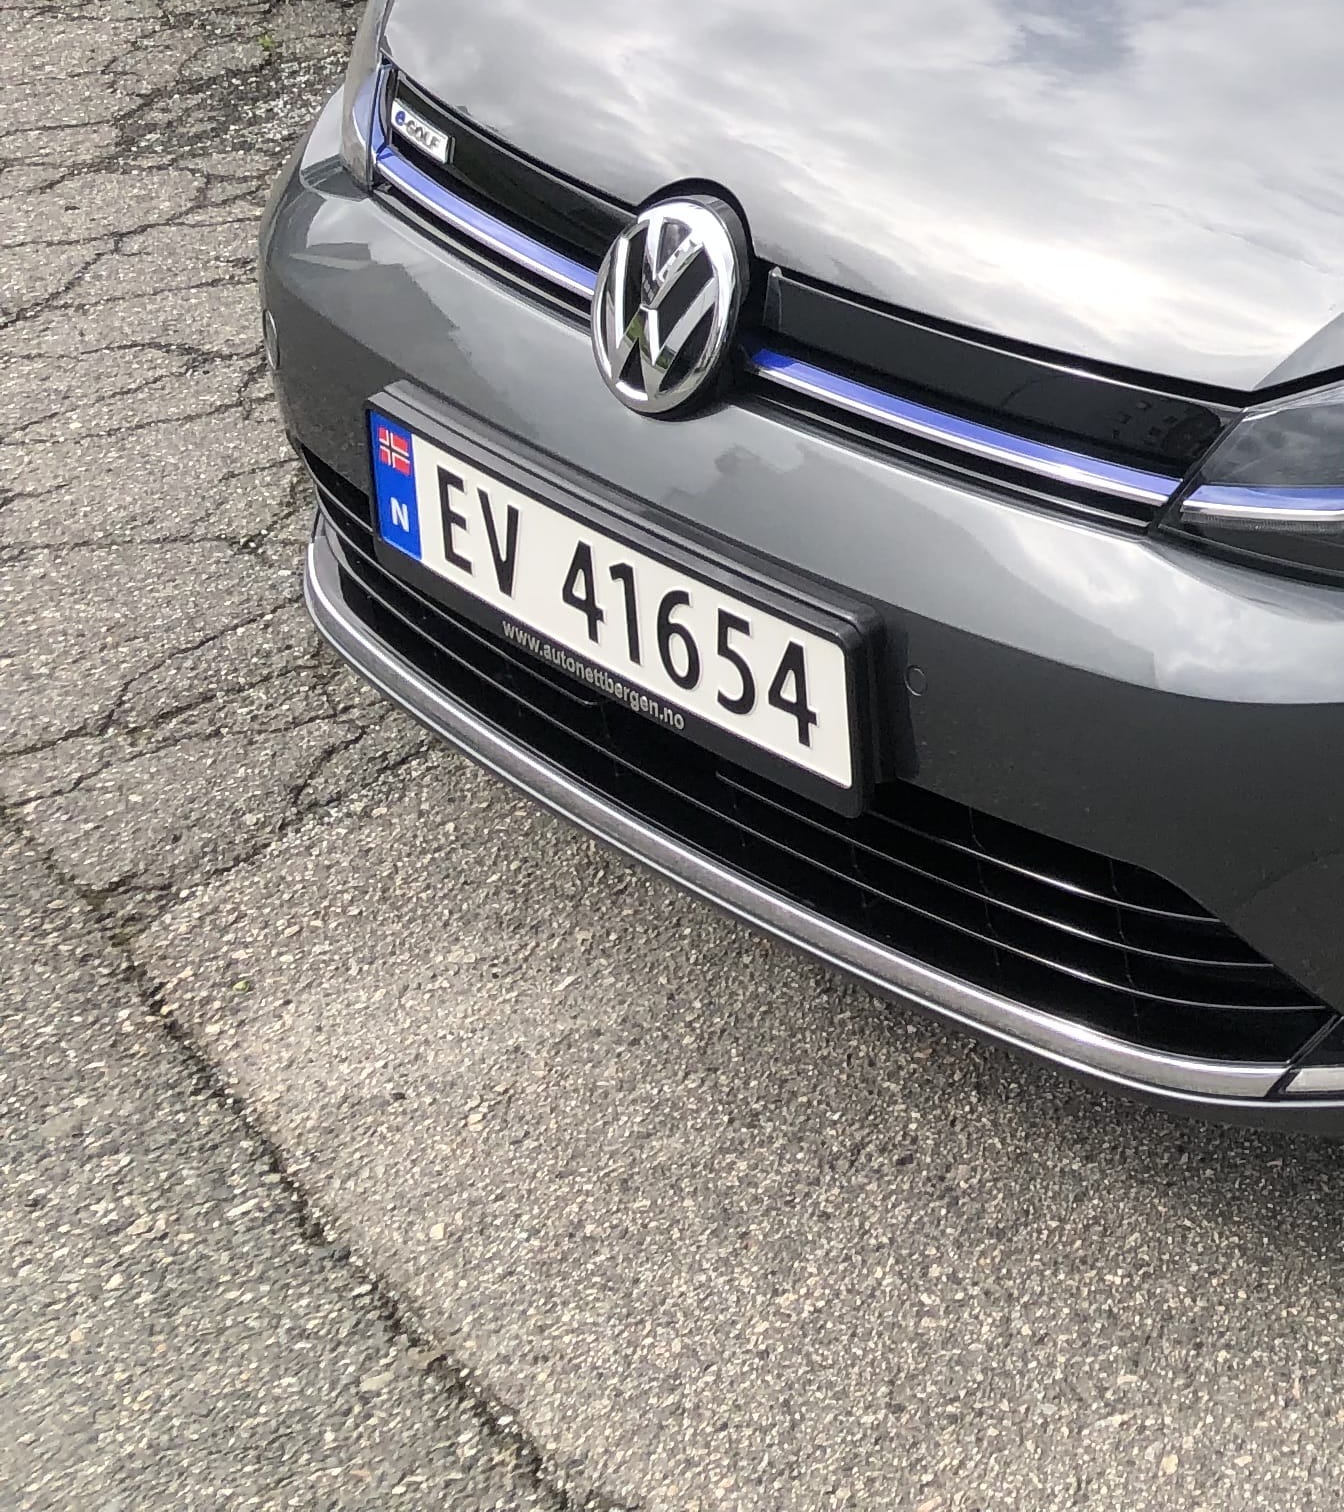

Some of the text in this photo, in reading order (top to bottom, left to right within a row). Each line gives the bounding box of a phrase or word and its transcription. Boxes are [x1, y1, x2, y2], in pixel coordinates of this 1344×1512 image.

[390, 497, 410, 534] N
[436, 464, 818, 749] EV 41654
[502, 620, 685, 730] www.autonettbergen.no
